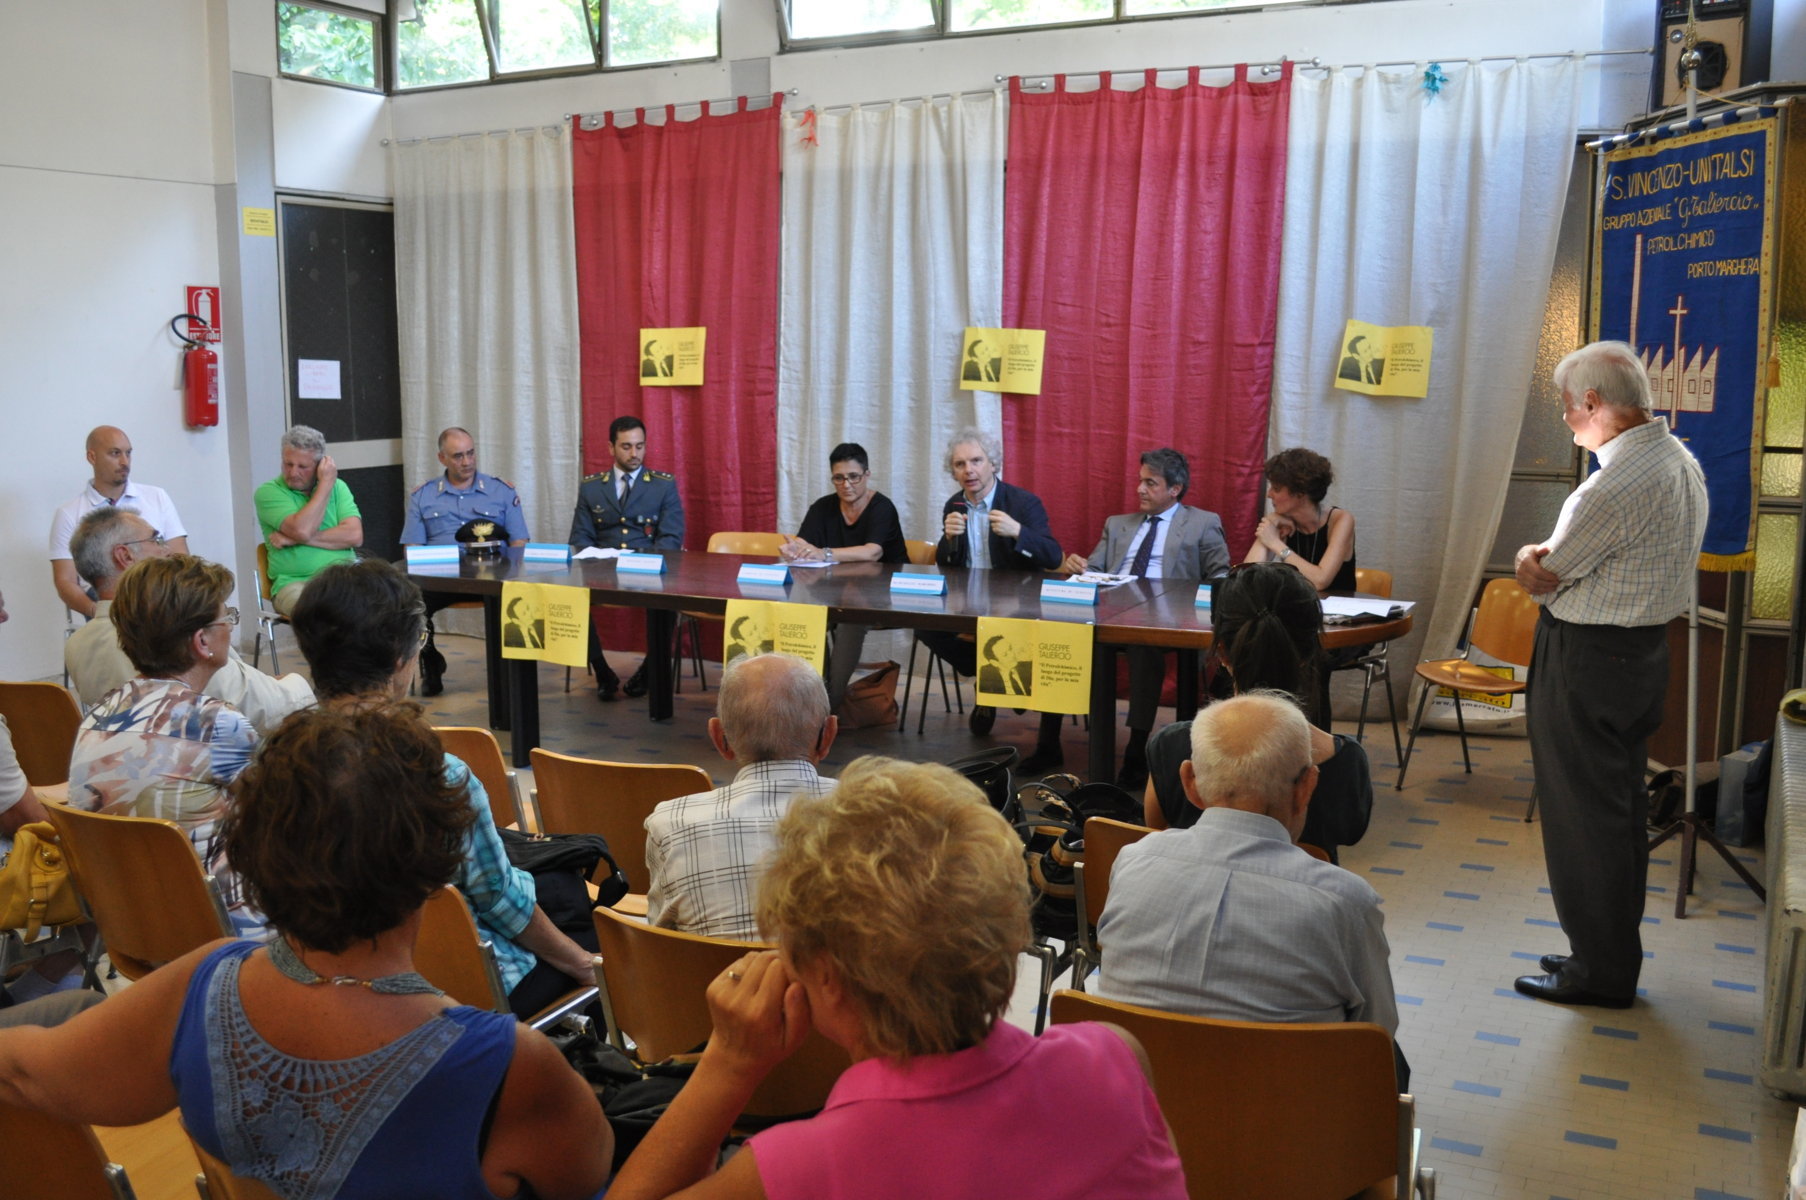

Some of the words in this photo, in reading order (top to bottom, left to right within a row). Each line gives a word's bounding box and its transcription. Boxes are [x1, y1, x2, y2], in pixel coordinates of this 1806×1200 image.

[1603, 212, 1636, 230] GRUPPO
[1687, 260, 1714, 279] PORTO
[1715, 257, 1760, 276] MARGHERA
[1039, 642, 1071, 652] GIUSEPPE
